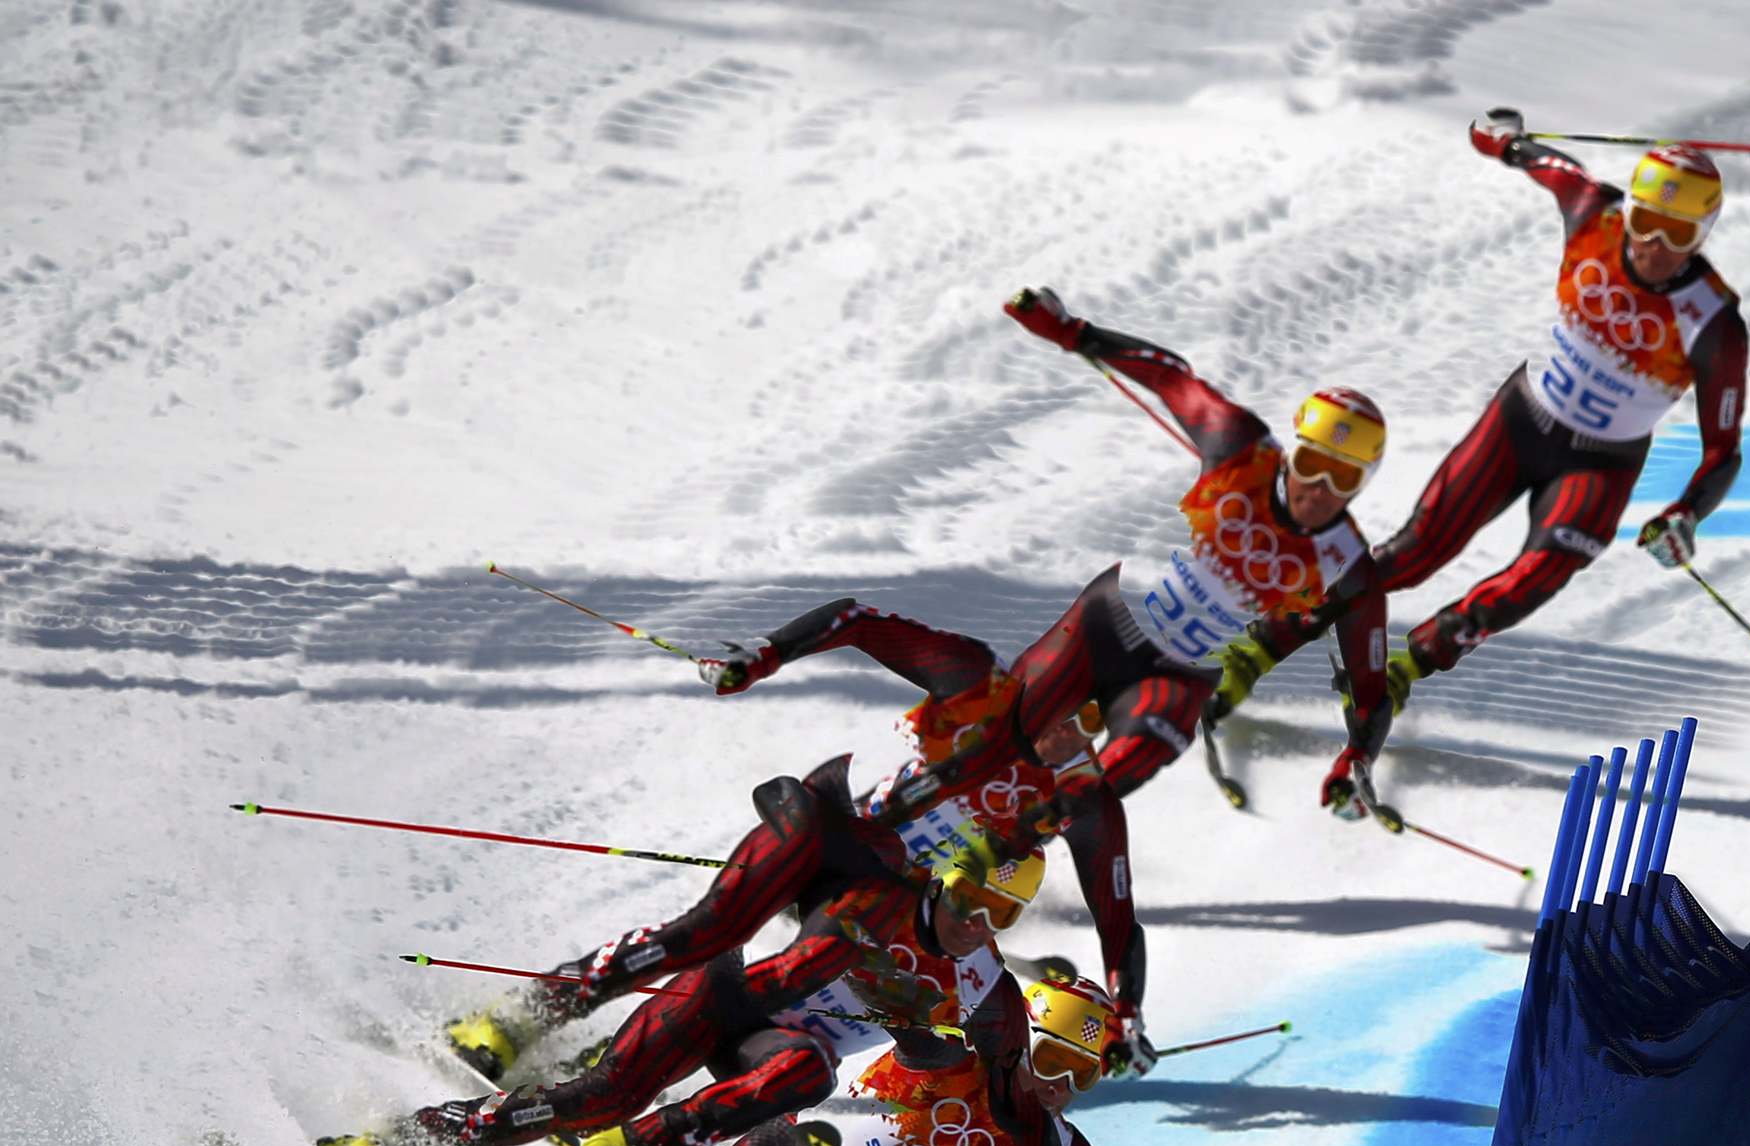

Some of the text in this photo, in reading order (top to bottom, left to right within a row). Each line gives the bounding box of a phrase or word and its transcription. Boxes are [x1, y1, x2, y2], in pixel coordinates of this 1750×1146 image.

[1543, 357, 1617, 430] 25
[1171, 551, 1208, 604] SOCHI
[1145, 579, 1222, 658] 25
